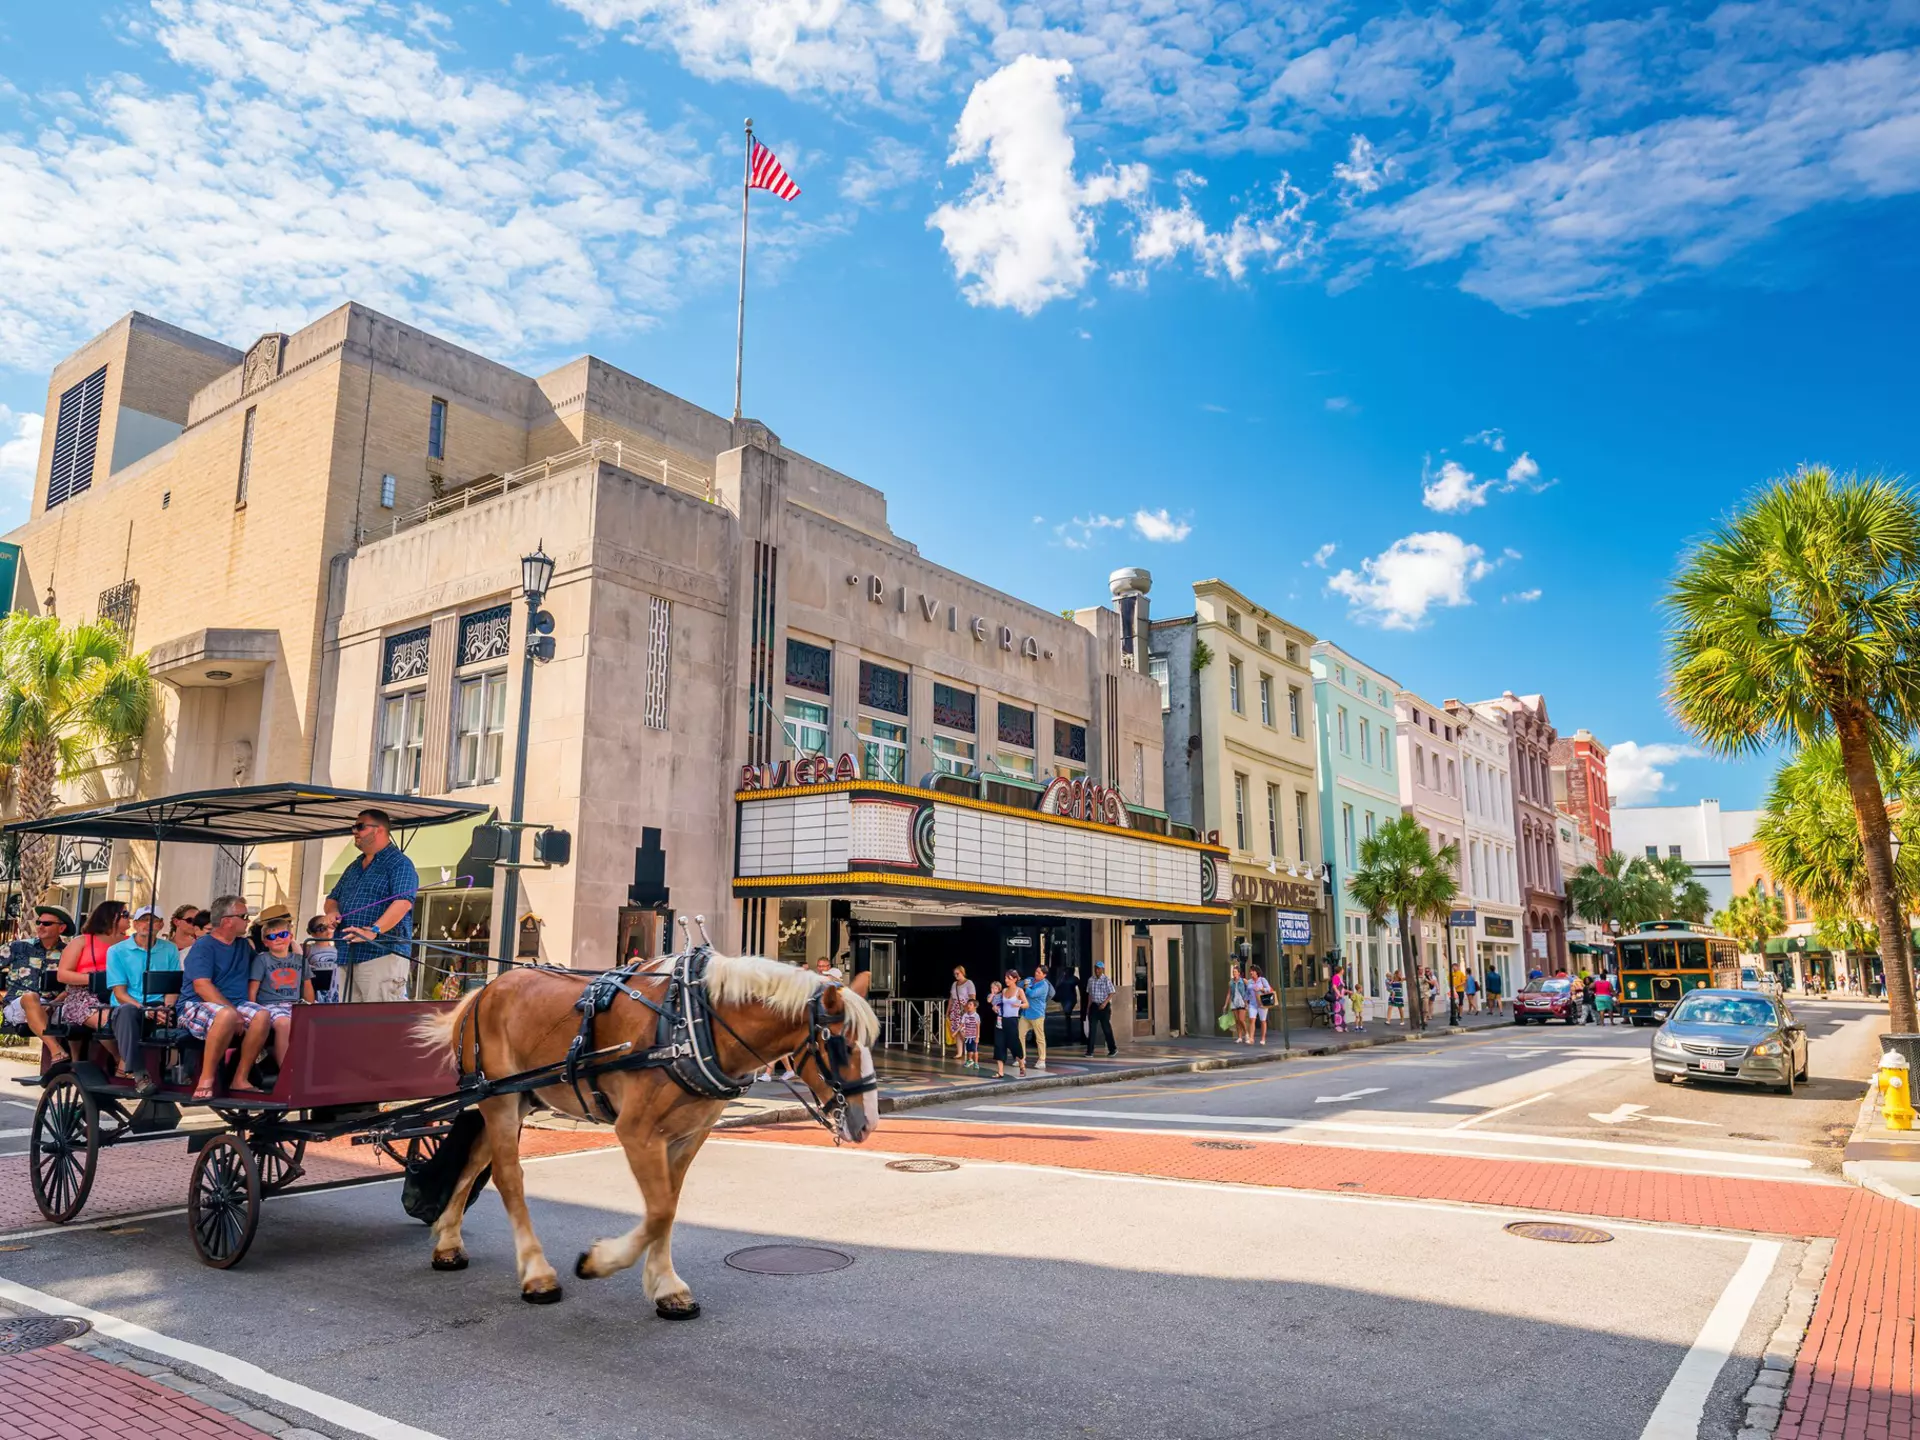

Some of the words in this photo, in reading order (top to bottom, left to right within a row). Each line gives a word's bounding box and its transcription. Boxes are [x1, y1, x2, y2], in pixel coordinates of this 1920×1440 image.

[868, 575, 1039, 662] RIVIERA
[741, 753, 860, 791] RIVIERA
[1232, 874, 1258, 901] OLD
[1260, 878, 1300, 906] TOWNE
